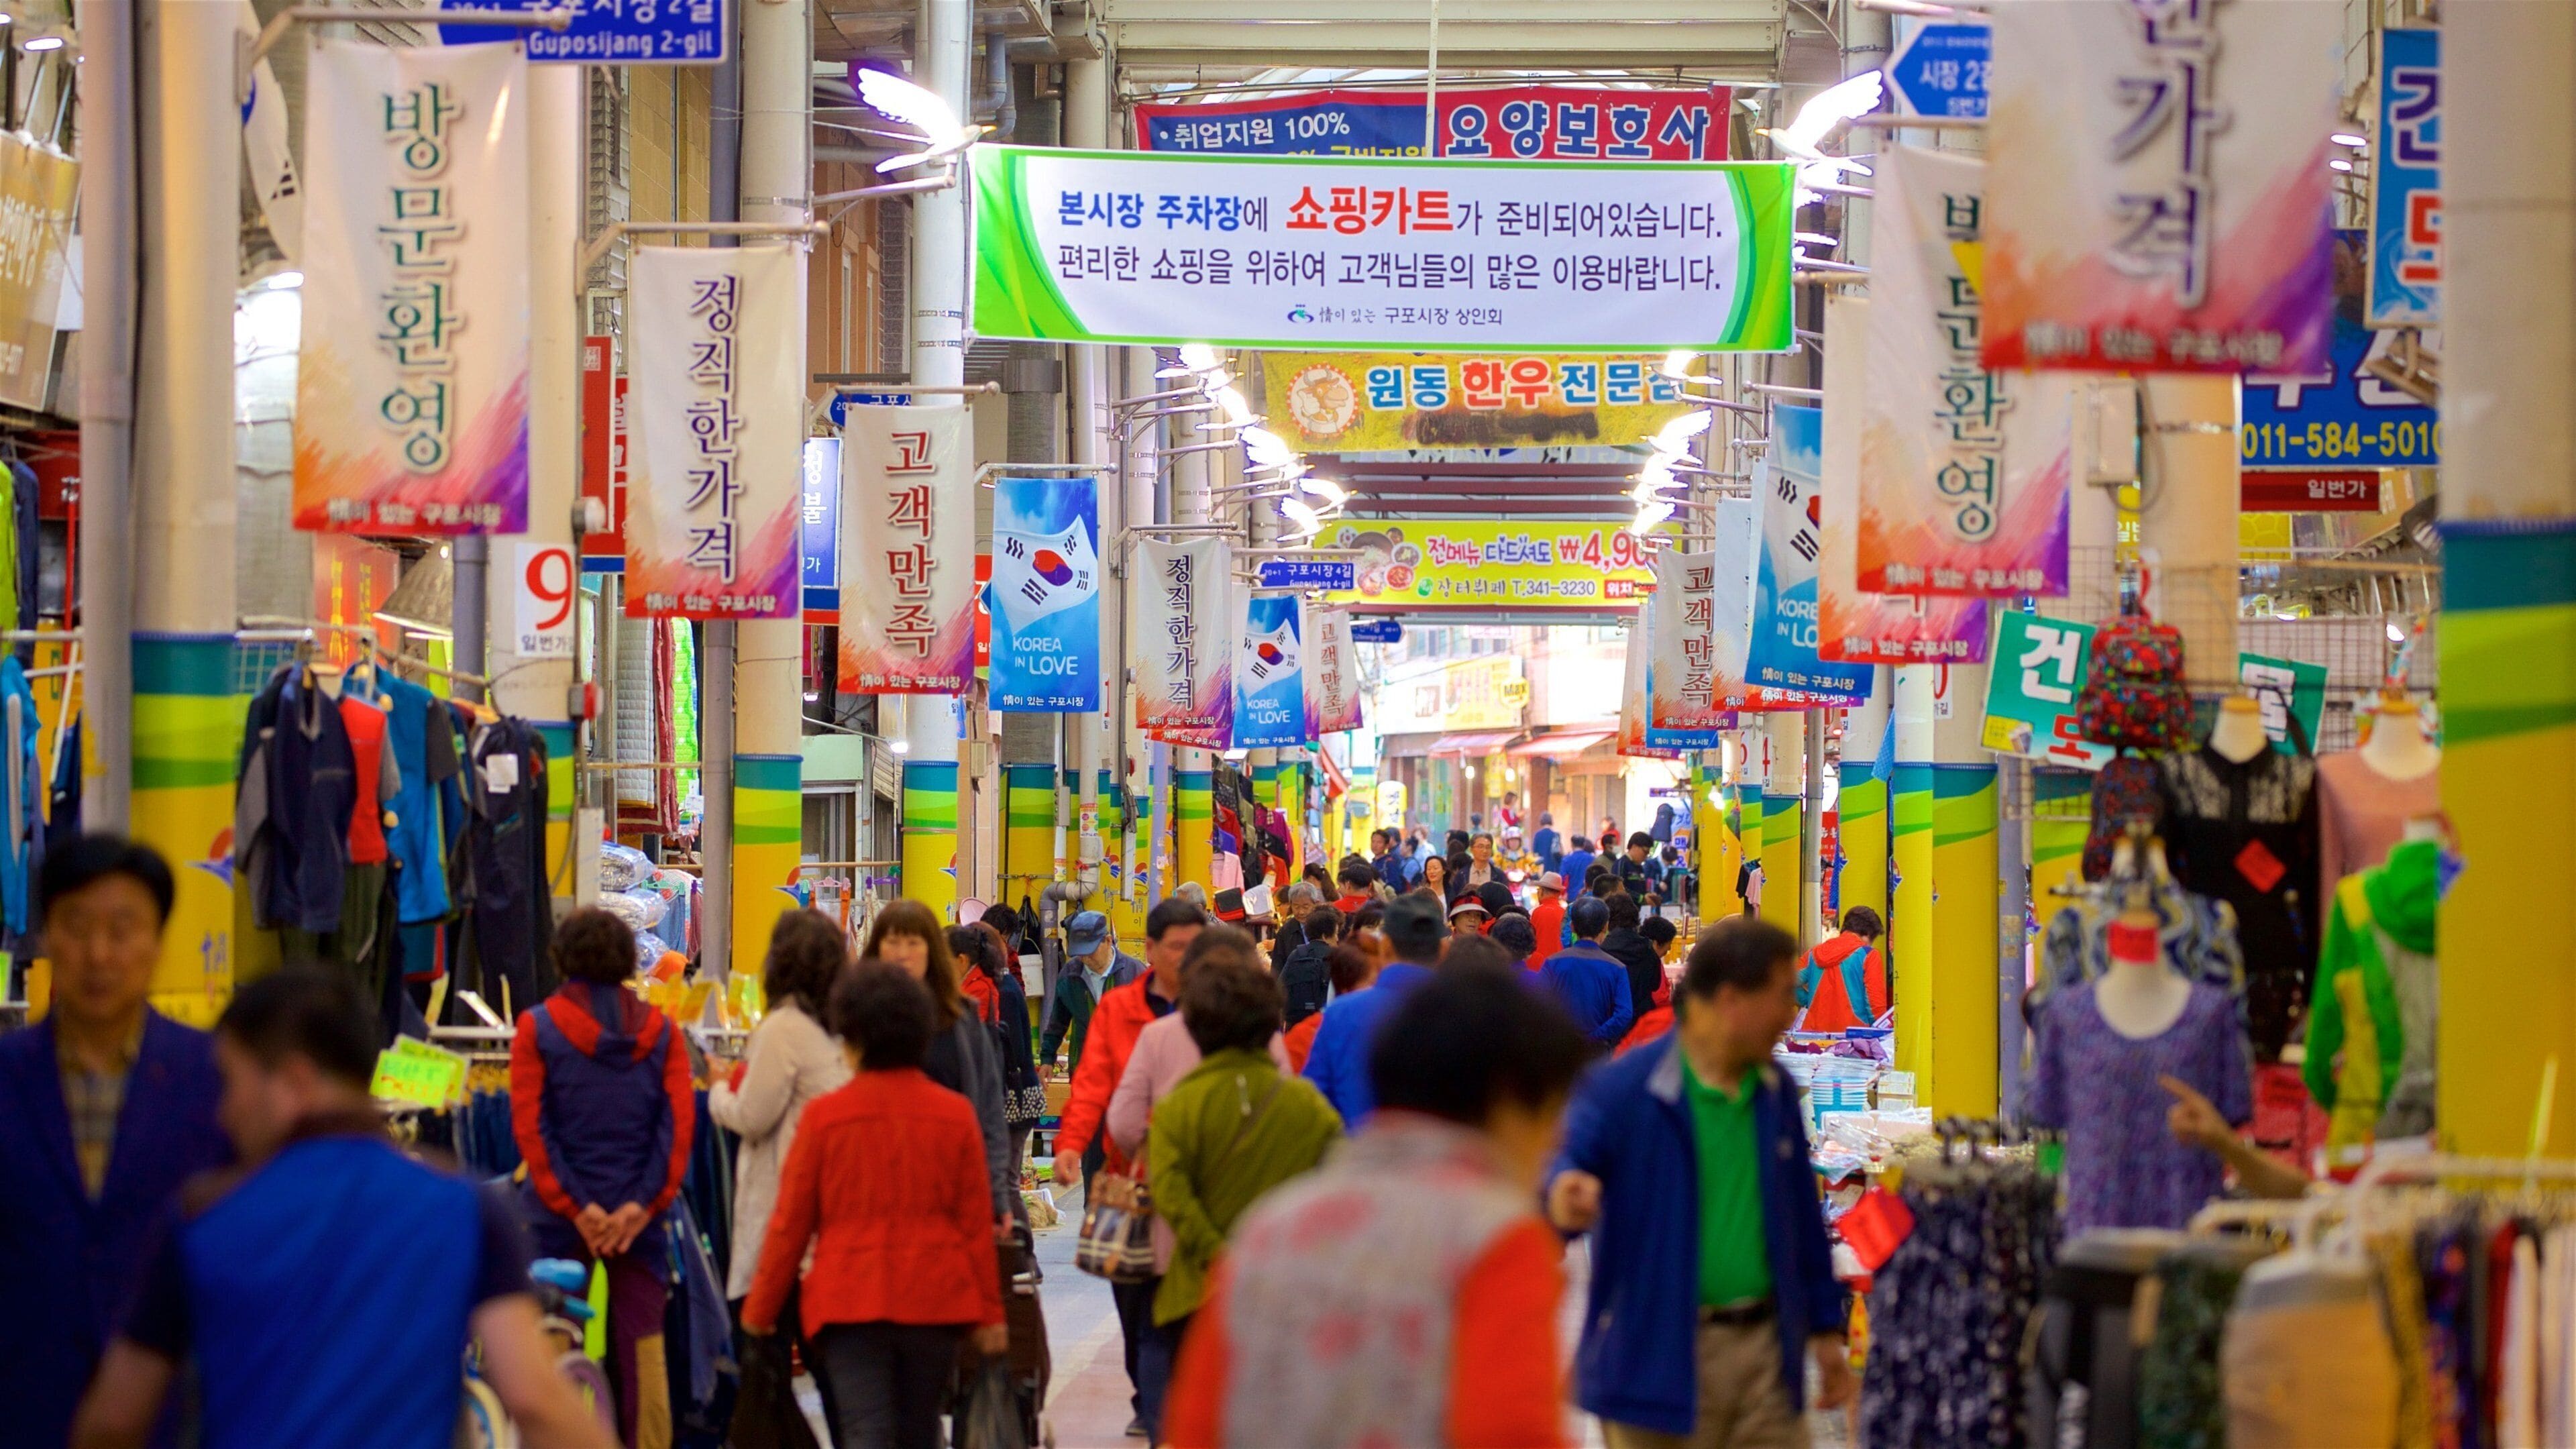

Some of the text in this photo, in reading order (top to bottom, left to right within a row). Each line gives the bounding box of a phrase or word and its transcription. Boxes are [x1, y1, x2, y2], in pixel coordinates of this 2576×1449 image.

[529, 30, 713, 57] Guposijang 2-gil
[1174, 111, 1350, 150] 취업지원 100%
[1446, 100, 1711, 160] 요양보호사
[1058, 185, 1723, 238] 본시장 주차장에 쇼핑카트가 준비되어있습니다.
[377, 82, 460, 468] 방문환영
[1057, 244, 1722, 292] 편리한 쇼핑을 위하여 고객님들의 많은 이용바랍니다.
[1319, 306, 1503, 325] 情이 있는 구포시장 상인회
[1368, 367, 1447, 409] 원동
[1462, 360, 1550, 408] 한우
[687, 272, 741, 584] 정직한가격
[2306, 479, 2367, 500] 일번가
[884, 429, 937, 658] 고객만족
[1427, 536, 1482, 566] 전메뉴
[1287, 564, 1352, 579] 구포시장 4길
[525, 547, 573, 631] 9
[1438, 578, 1635, 598] 장터뷔페 T.341-3230 위치
[717, 594, 777, 612] 구포시장
[1165, 554, 1196, 710] 정직한가격
[1680, 566, 1714, 708] 고객만족
[1776, 621, 1789, 637] IN
[521, 634, 574, 652] 일번가
[1012, 636, 1063, 653] KOREA
[1909, 640, 1970, 657] 구포시장
[1014, 655, 1079, 676] IN LOVE
[1321, 623, 1347, 716] 고객만족
[2019, 623, 2082, 705] 건
[889, 674, 912, 688] 있는
[915, 675, 961, 689] 구포시장
[1762, 666, 1856, 691] 情이 있는 구포시장
[1002, 694, 1085, 707] 情이 있는 구포시장
[1246, 698, 1280, 710] KOREA
[1725, 696, 1744, 707] 情이
[1786, 691, 1805, 702] 있는
[1167, 716, 1182, 725] 있는
[1184, 715, 1216, 725] 구포시장
[1248, 710, 1291, 724] IN LOVE
[1683, 718, 1697, 727] 있는
[1701, 717, 1729, 727] 구포시장
[1181, 733, 1193, 743] 있는
[1195, 735, 1222, 748] 구포시장
[1272, 736, 1296, 744] 구포시장
[1685, 738, 1709, 746] 구포시장
